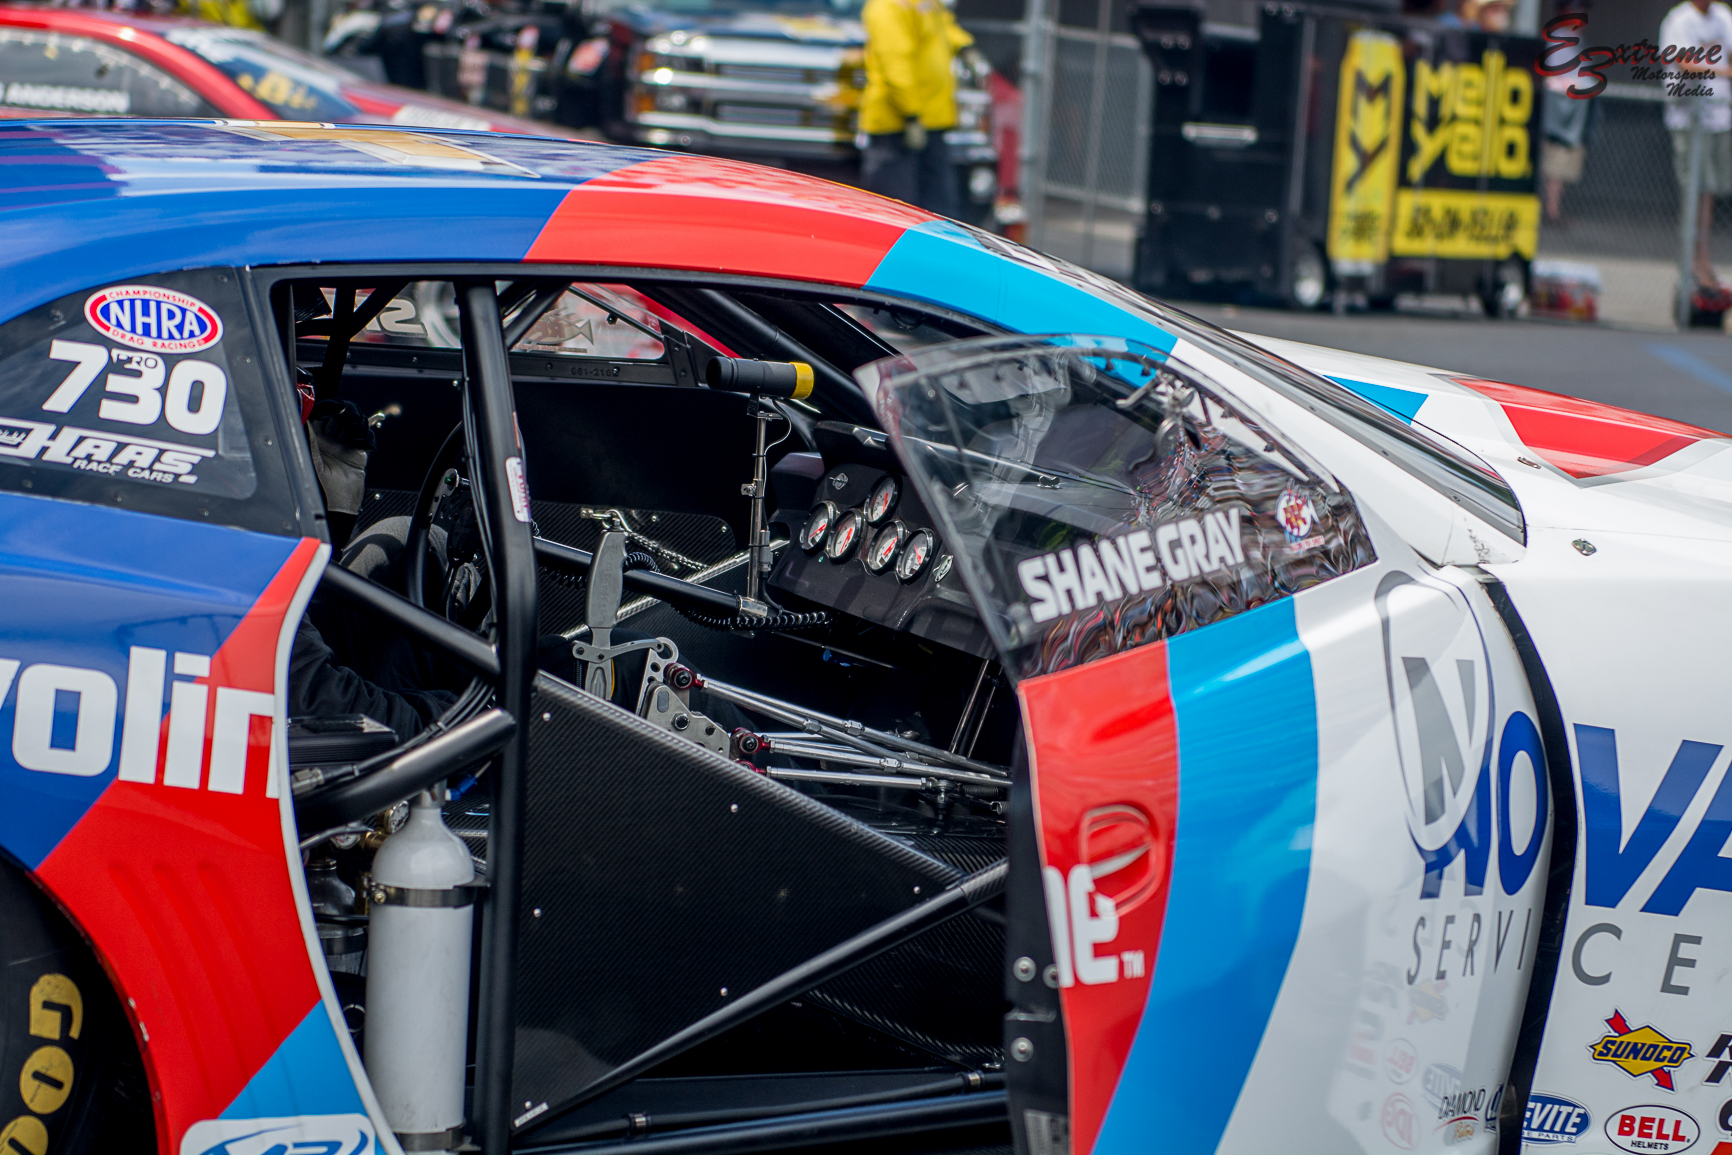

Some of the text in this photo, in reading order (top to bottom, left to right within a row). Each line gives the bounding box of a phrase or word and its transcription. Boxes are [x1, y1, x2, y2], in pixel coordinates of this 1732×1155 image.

[109, 290, 196, 308] CHAMPIONSHIP
[109, 299, 201, 340] NHRA
[112, 329, 196, 351] DRAG RACING
[112, 353, 158, 369] PRO
[42, 339, 228, 435] 730
[0, 417, 216, 475] HAAS
[73, 459, 175, 484] RACE CARS
[1017, 507, 1245, 624] SHANE GRAY
[1597, 1040, 1688, 1064] SUNOCO
[1538, 1132, 1574, 1141] PARTS
[1617, 1114, 1686, 1142] BELL
[1630, 1140, 1669, 1151] HELMETS
